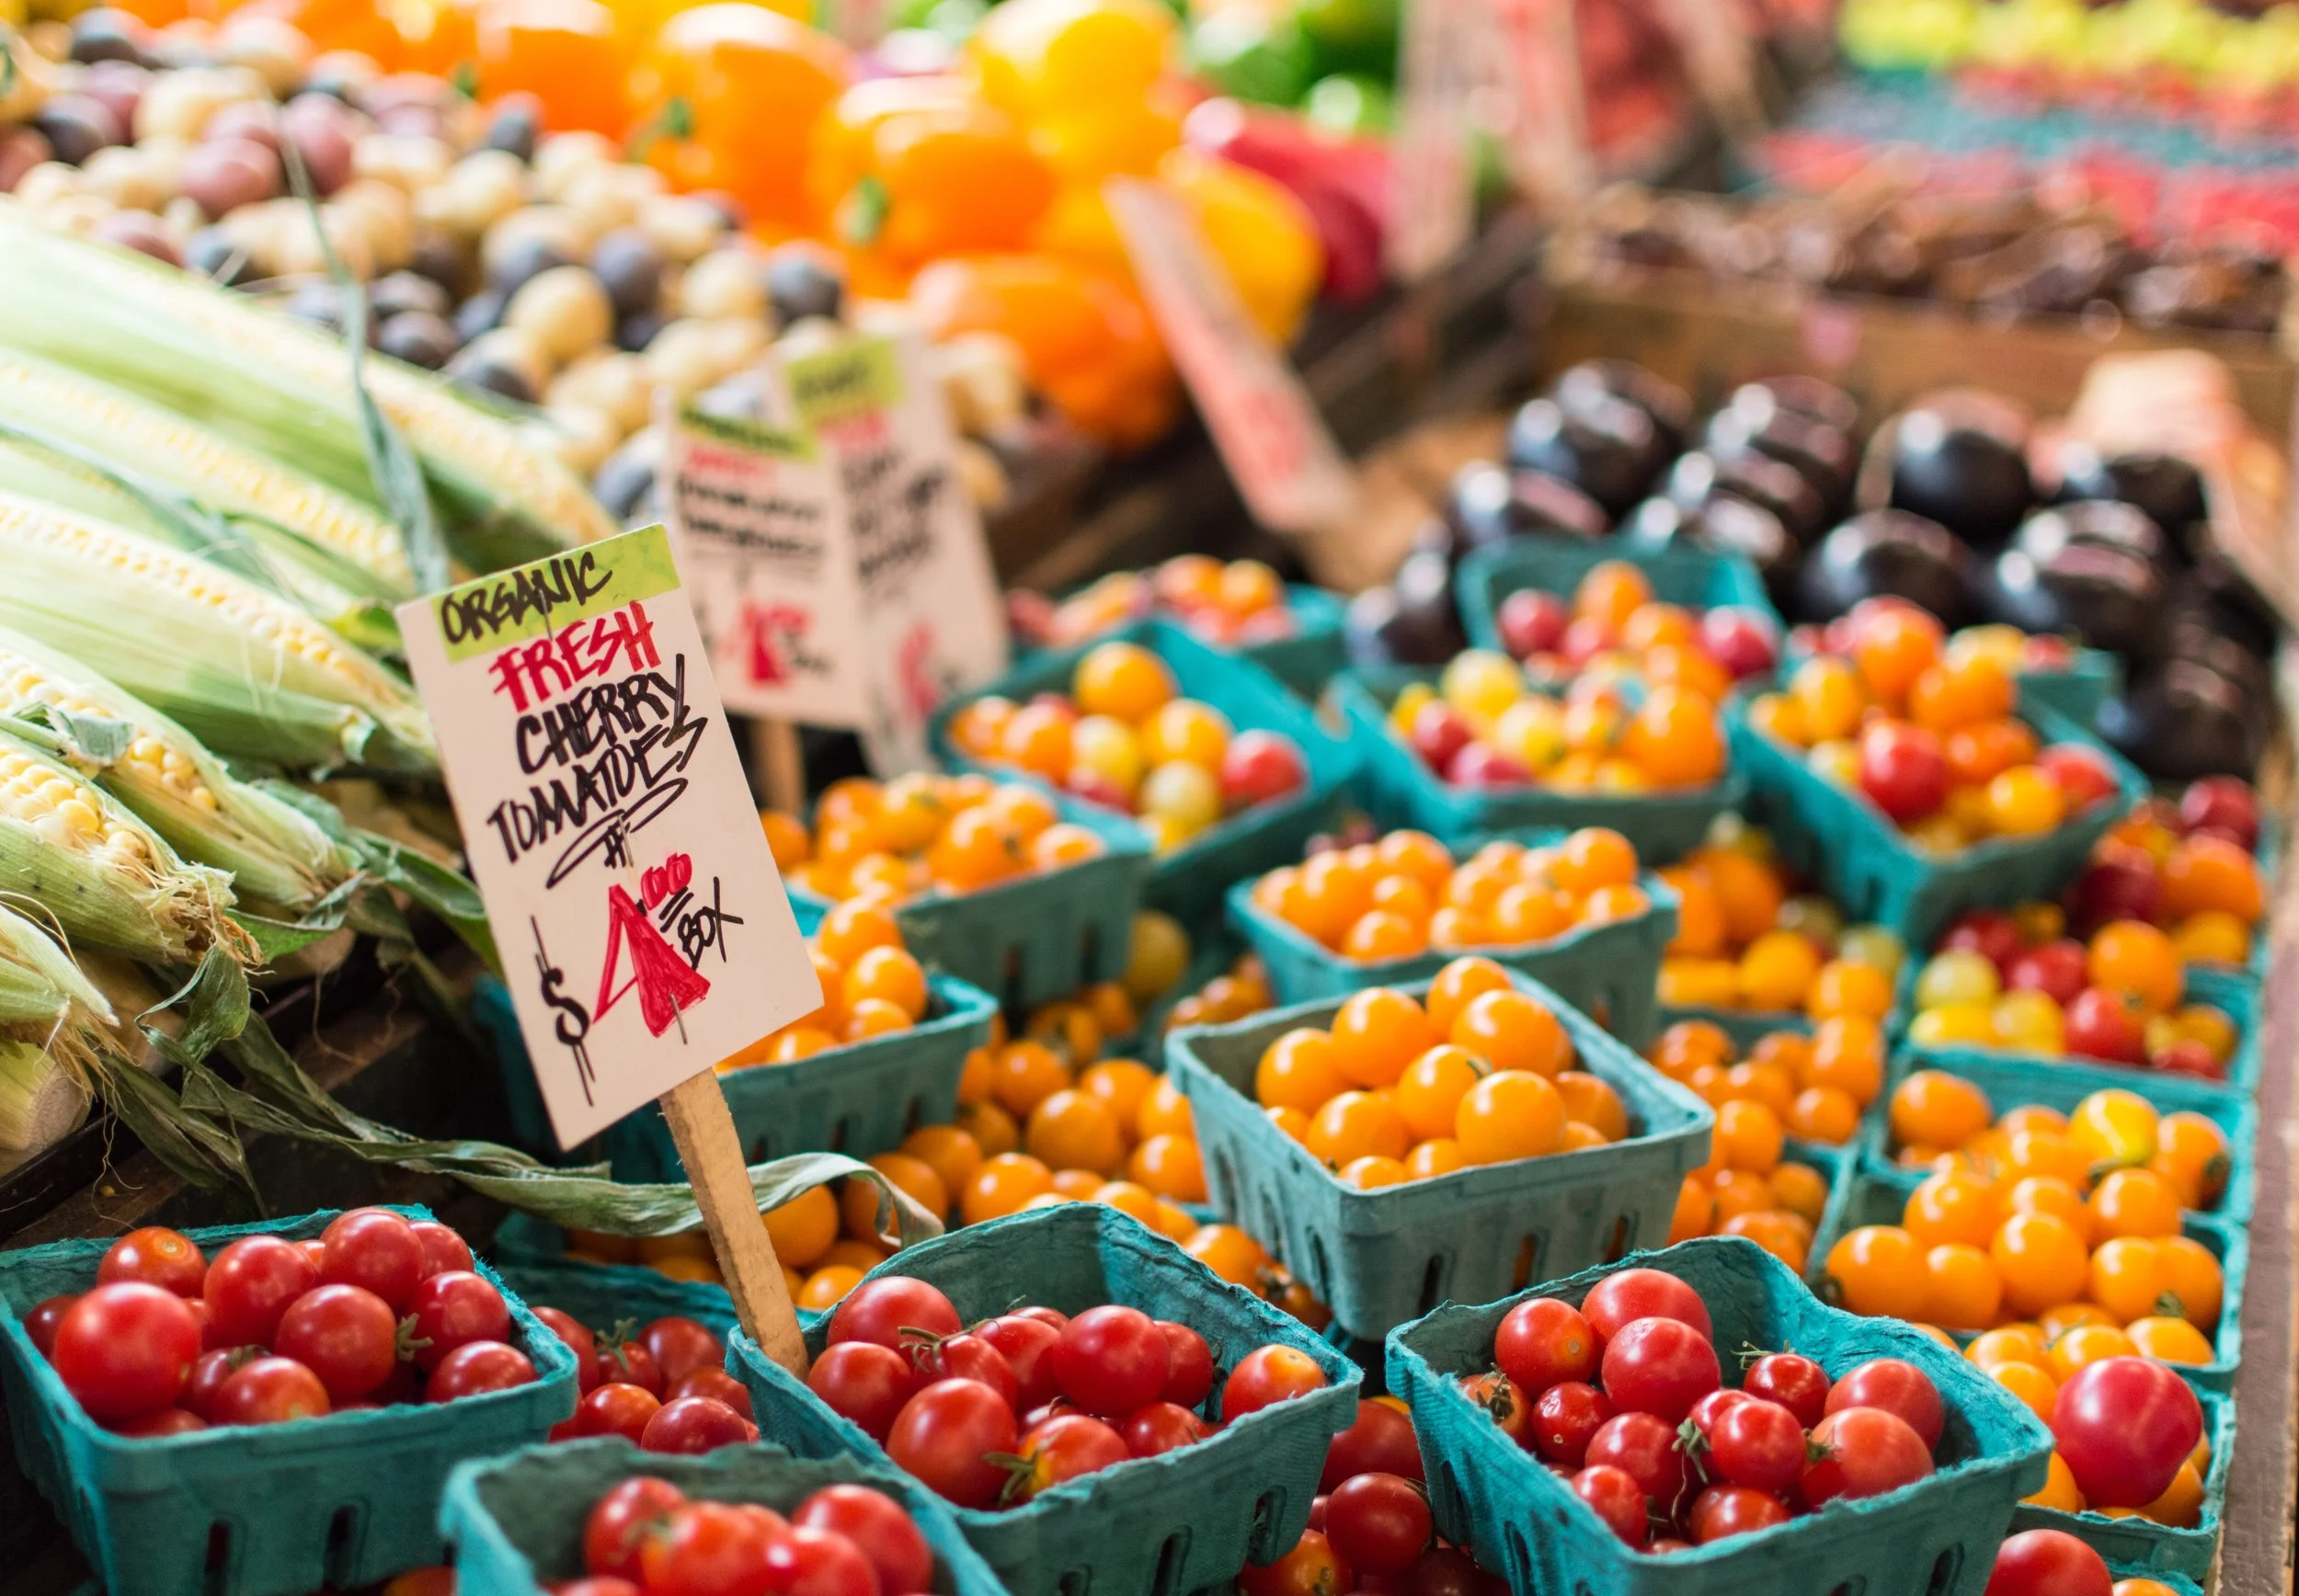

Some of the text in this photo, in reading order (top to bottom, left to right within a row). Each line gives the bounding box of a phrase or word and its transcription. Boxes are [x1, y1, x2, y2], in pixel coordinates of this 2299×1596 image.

[440, 551, 613, 644] ORGANIC
[487, 599, 662, 713] FRESH
[515, 653, 686, 775] CHERRY
[486, 705, 709, 864] TOMATOES
[677, 875, 744, 973] BOX
